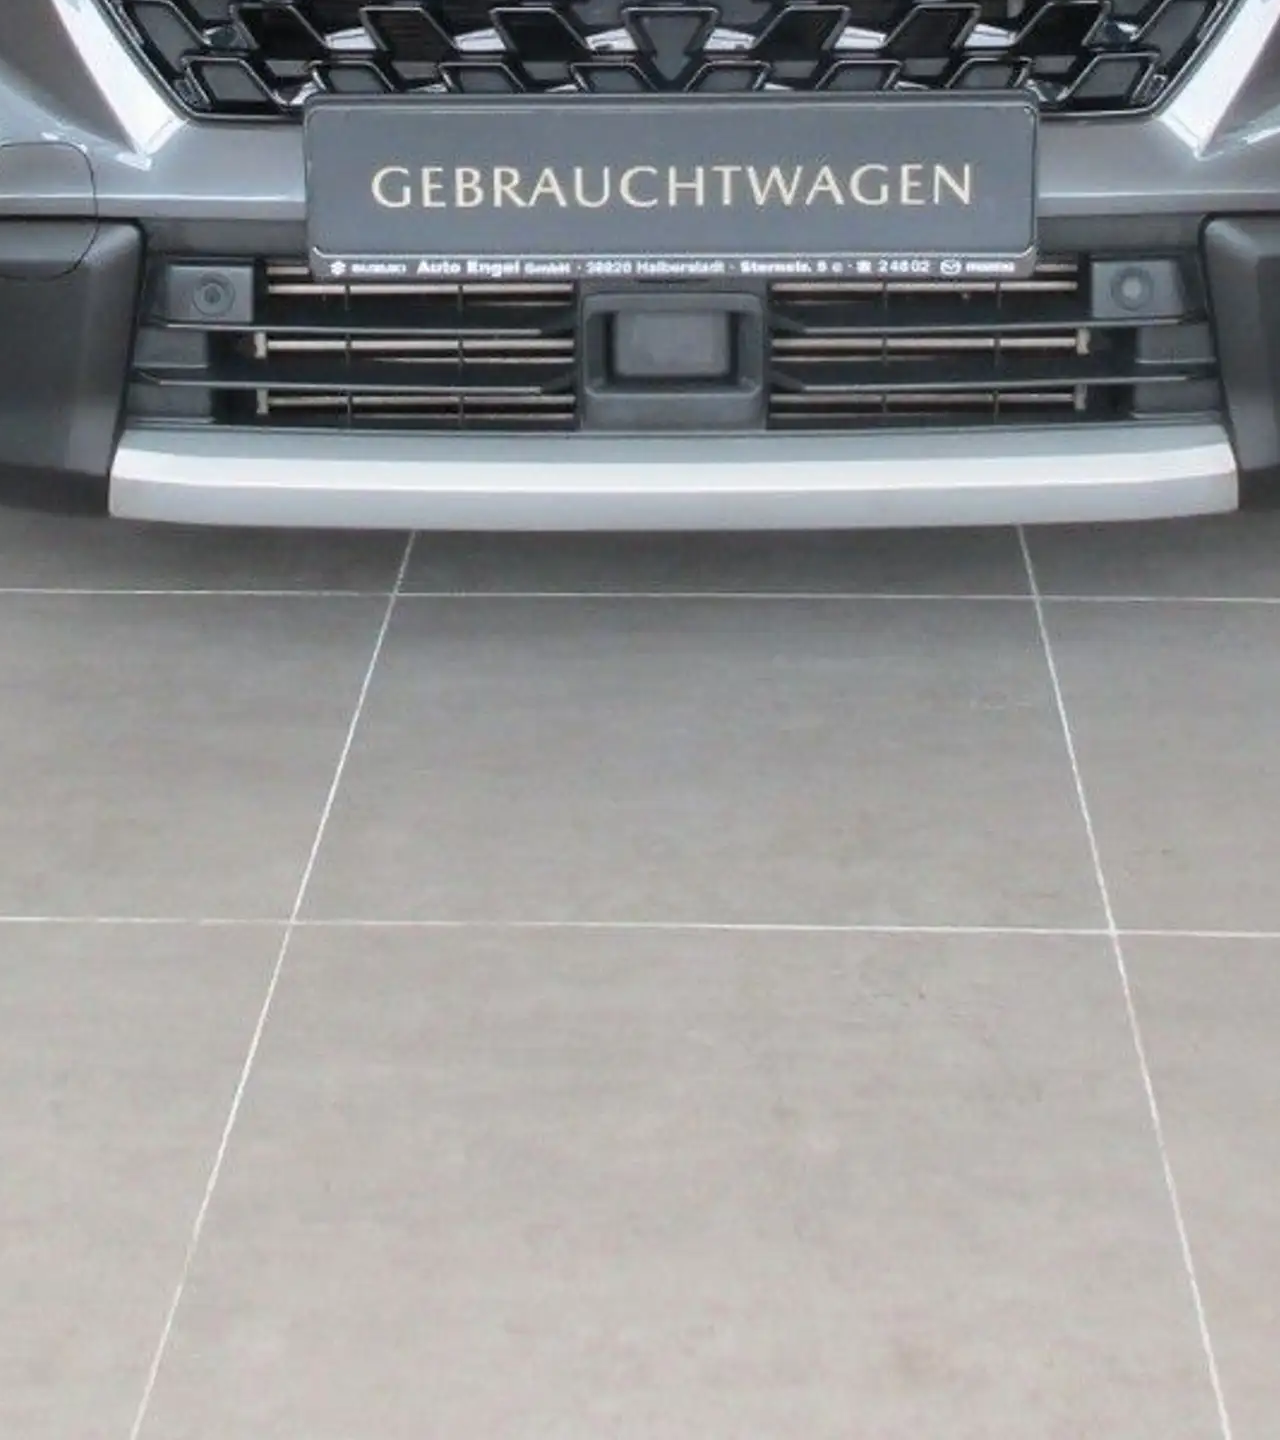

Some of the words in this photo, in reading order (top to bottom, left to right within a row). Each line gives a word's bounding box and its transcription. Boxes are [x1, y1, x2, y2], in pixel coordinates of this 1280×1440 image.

[370, 163, 971, 209] GEBRAUCHTWAGEN
[416, 259, 461, 275] Auto
[466, 259, 520, 278] Engel
